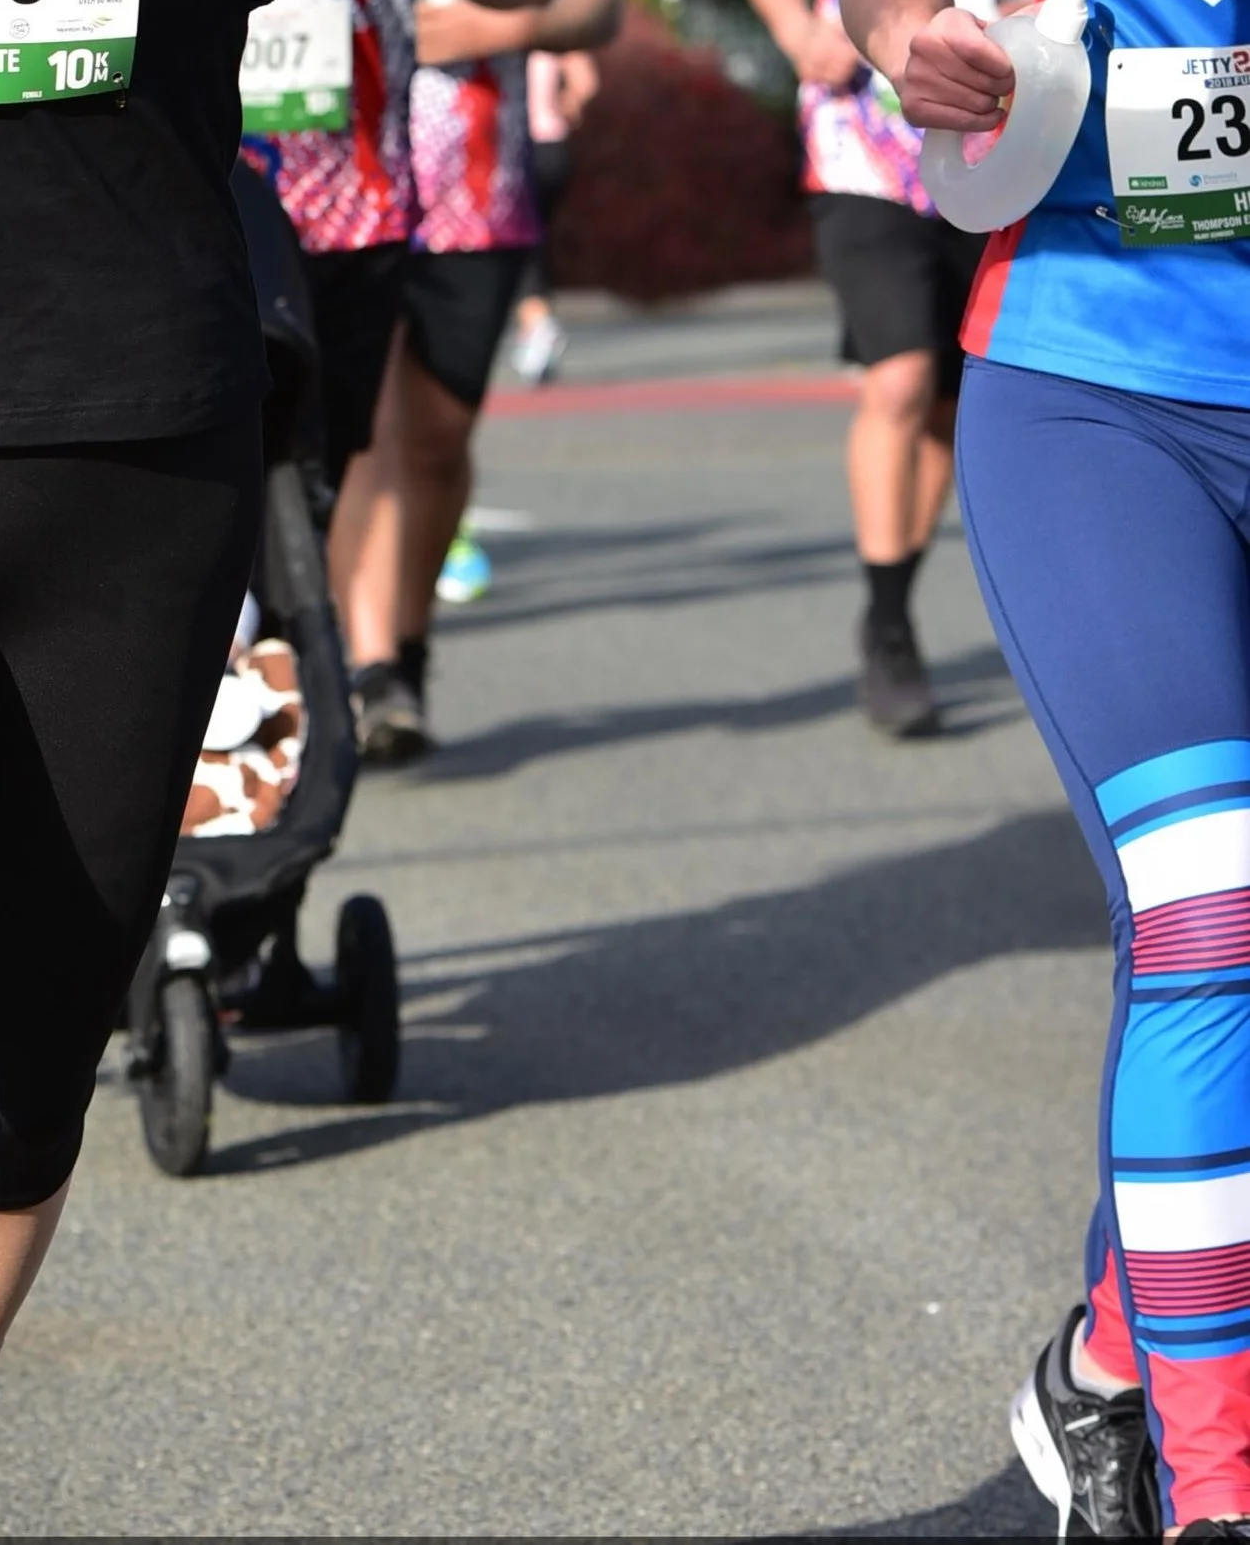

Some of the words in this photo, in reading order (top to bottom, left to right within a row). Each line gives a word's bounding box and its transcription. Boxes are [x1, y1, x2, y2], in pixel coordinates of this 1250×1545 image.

[47, 48, 94, 91] 10
[1182, 57, 1231, 75] JETTY
[1192, 215, 1242, 232] THOMPSON
